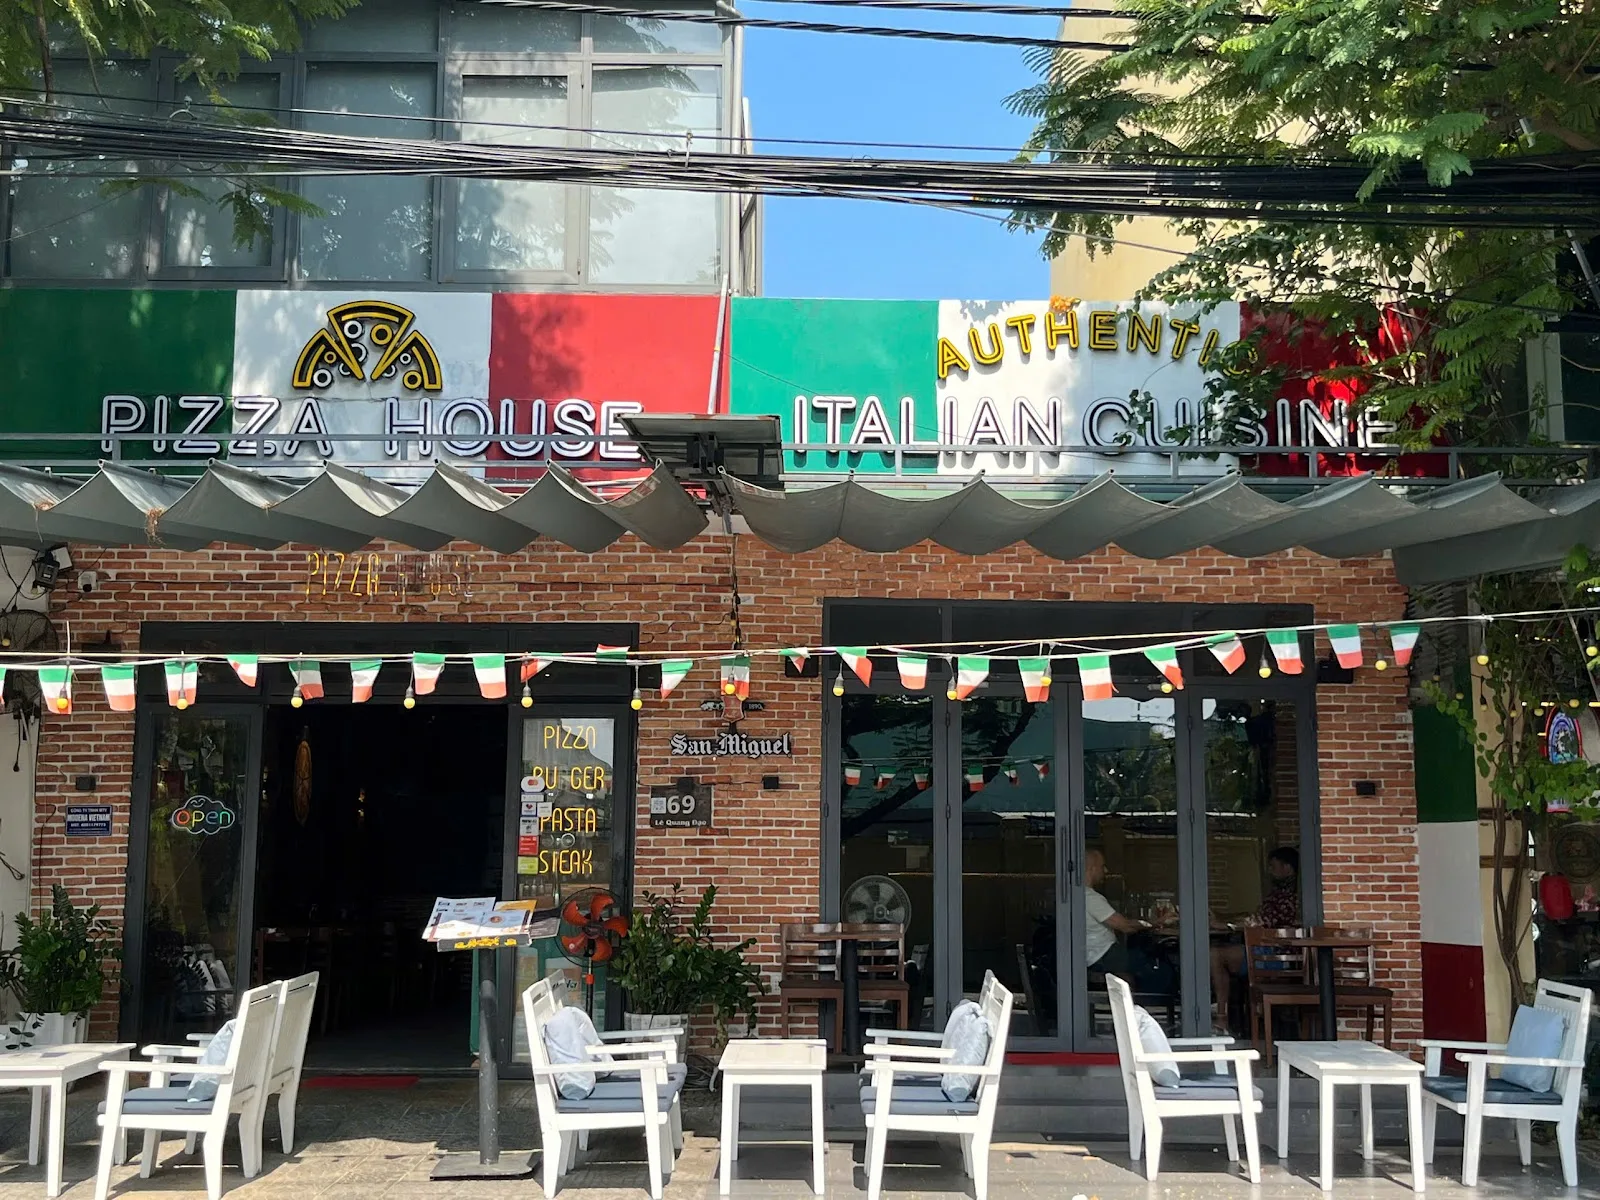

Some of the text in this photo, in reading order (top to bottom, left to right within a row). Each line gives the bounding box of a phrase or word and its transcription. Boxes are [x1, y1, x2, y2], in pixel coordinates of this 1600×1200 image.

[100, 395, 645, 459] PIZZA HOUSE
[793, 395, 1062, 455] ITALIAN
[544, 725, 596, 749] PIZZA
[670, 732, 790, 759] San Miguel
[667, 795, 696, 814] 69
[176, 810, 231, 827] open
[540, 807, 596, 833] PASTA
[666, 819, 690, 827] Quang
